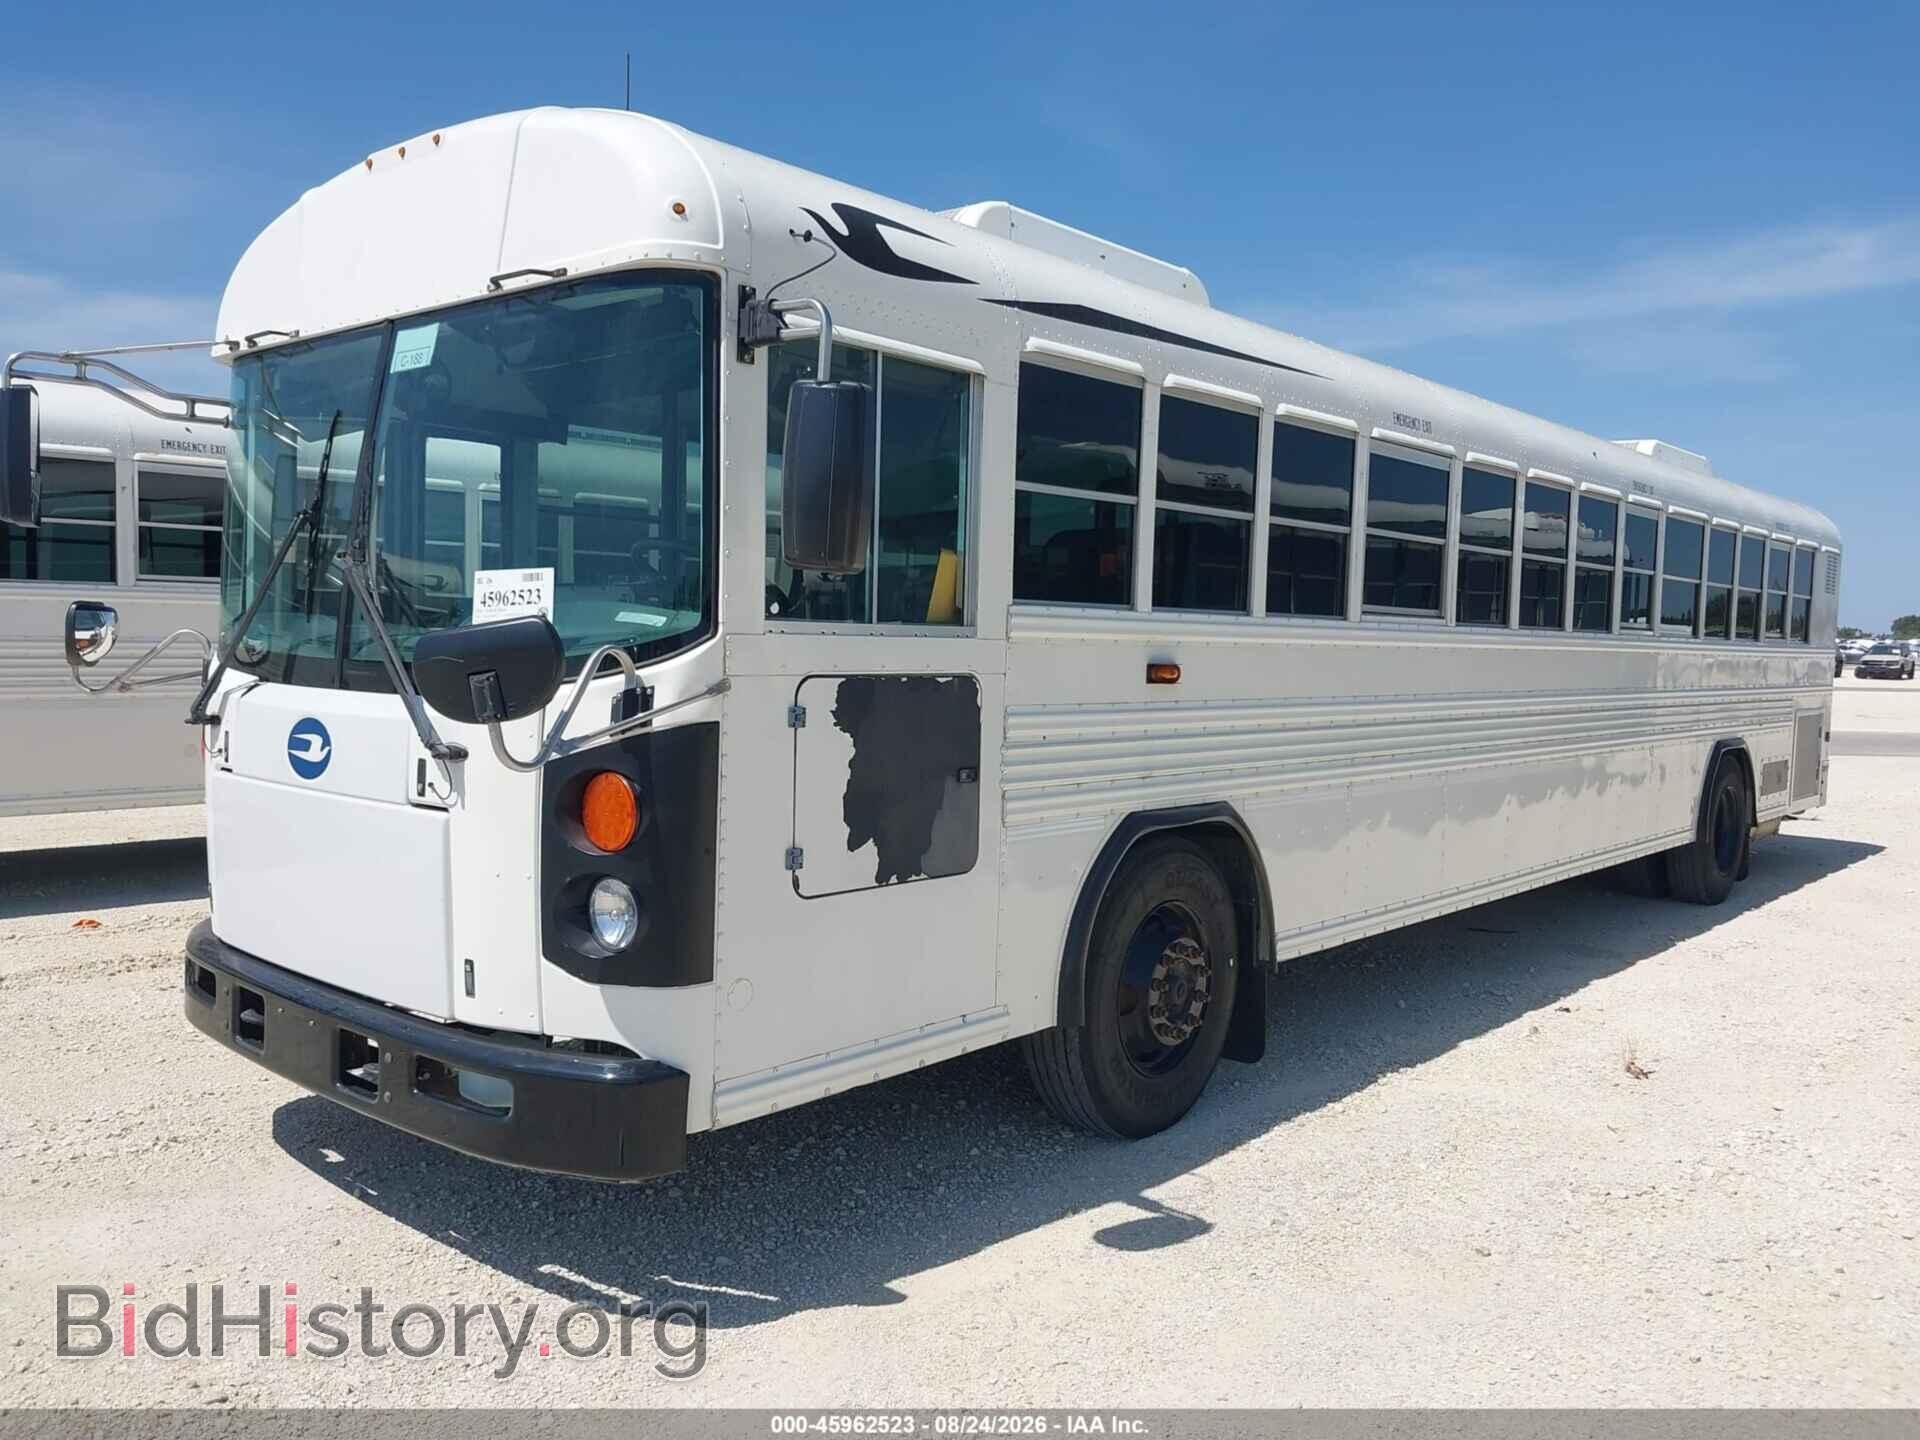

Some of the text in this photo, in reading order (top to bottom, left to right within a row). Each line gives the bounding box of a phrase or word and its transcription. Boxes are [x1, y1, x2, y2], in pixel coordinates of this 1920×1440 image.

[160, 439, 227, 455] EMERGENCY EXIT
[480, 588, 542, 608] 45962523
